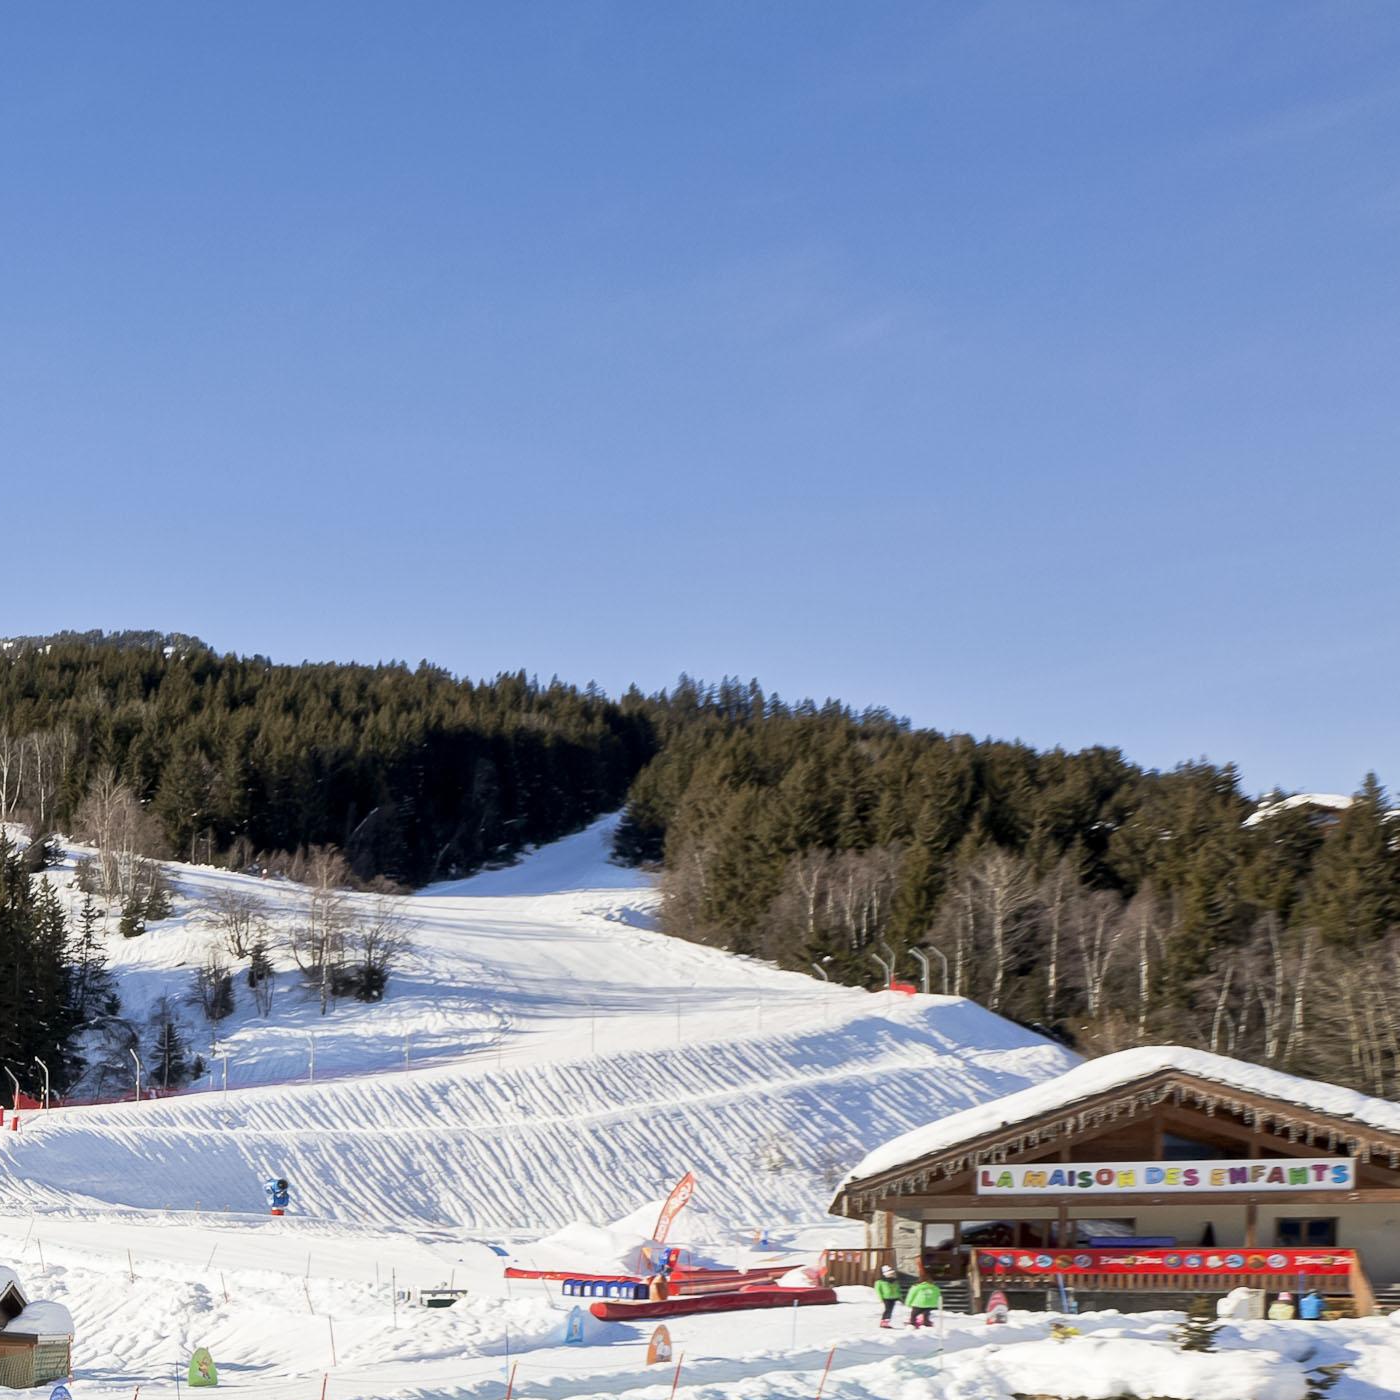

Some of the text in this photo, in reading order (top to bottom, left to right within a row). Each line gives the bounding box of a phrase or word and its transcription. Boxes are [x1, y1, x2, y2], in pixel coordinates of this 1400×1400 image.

[981, 1164, 1350, 1189] LA MAISON DES ENFANTS
